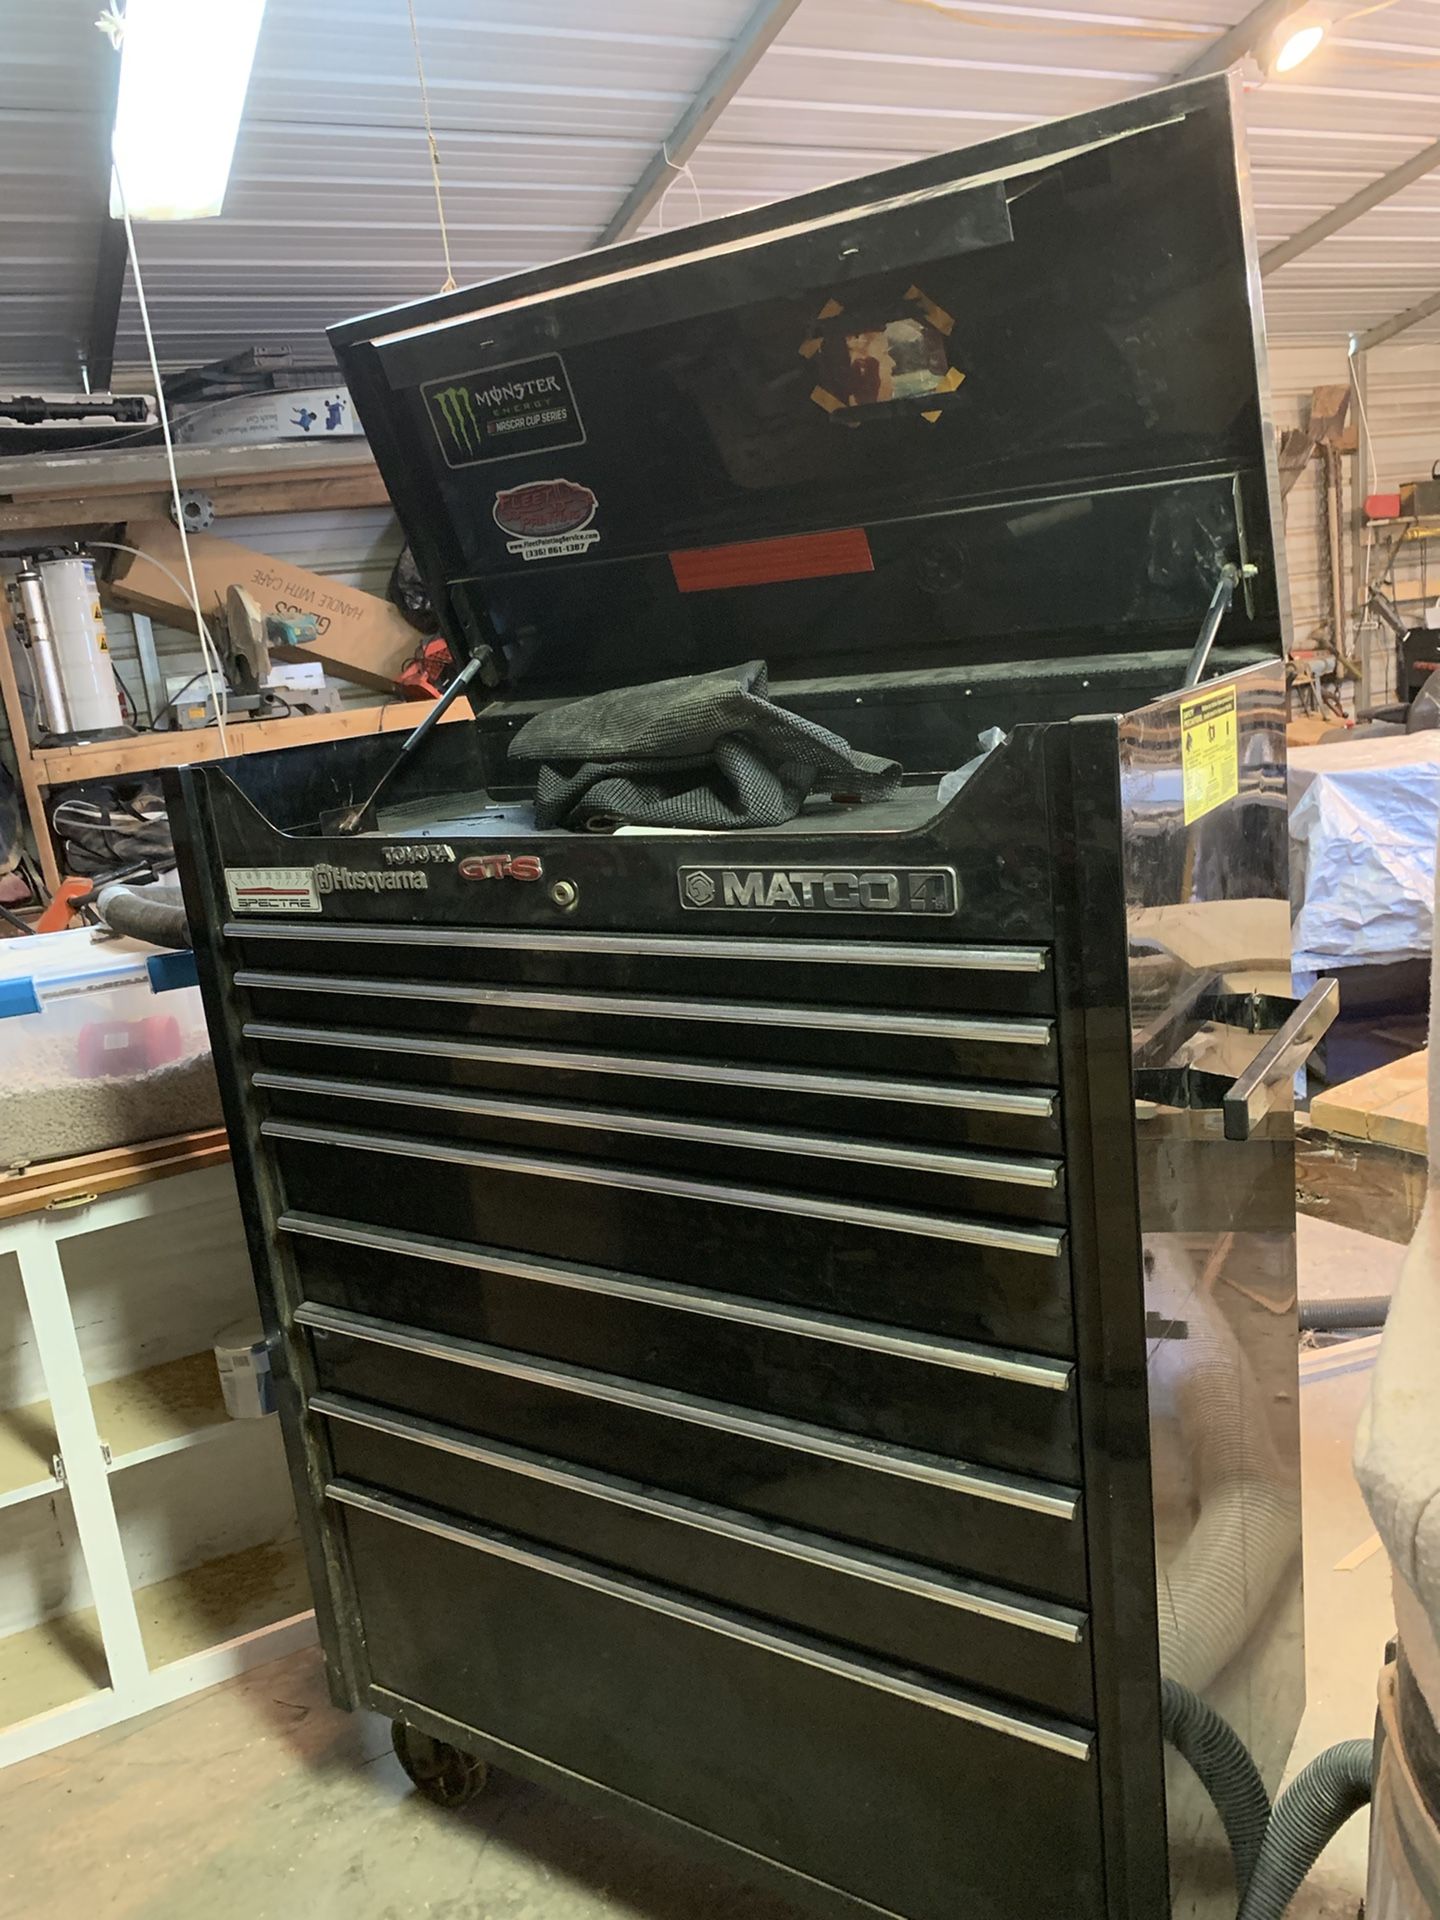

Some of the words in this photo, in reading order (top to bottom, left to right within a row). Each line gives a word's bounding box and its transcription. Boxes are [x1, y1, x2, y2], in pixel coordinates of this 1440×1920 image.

[475, 376, 561, 406] MONSTER
[496, 417, 525, 432] NASCAR
[526, 413, 541, 427] CUP
[541, 408, 568, 423] SERIES
[250, 569, 283, 591] CARE
[284, 582, 316, 604] WITH
[318, 594, 364, 620] HANDLE
[382, 844, 456, 865] TOYOTA
[332, 866, 428, 893] Husqvarna
[721, 871, 898, 909] MATCO
[237, 898, 311, 908] SPECTRE
